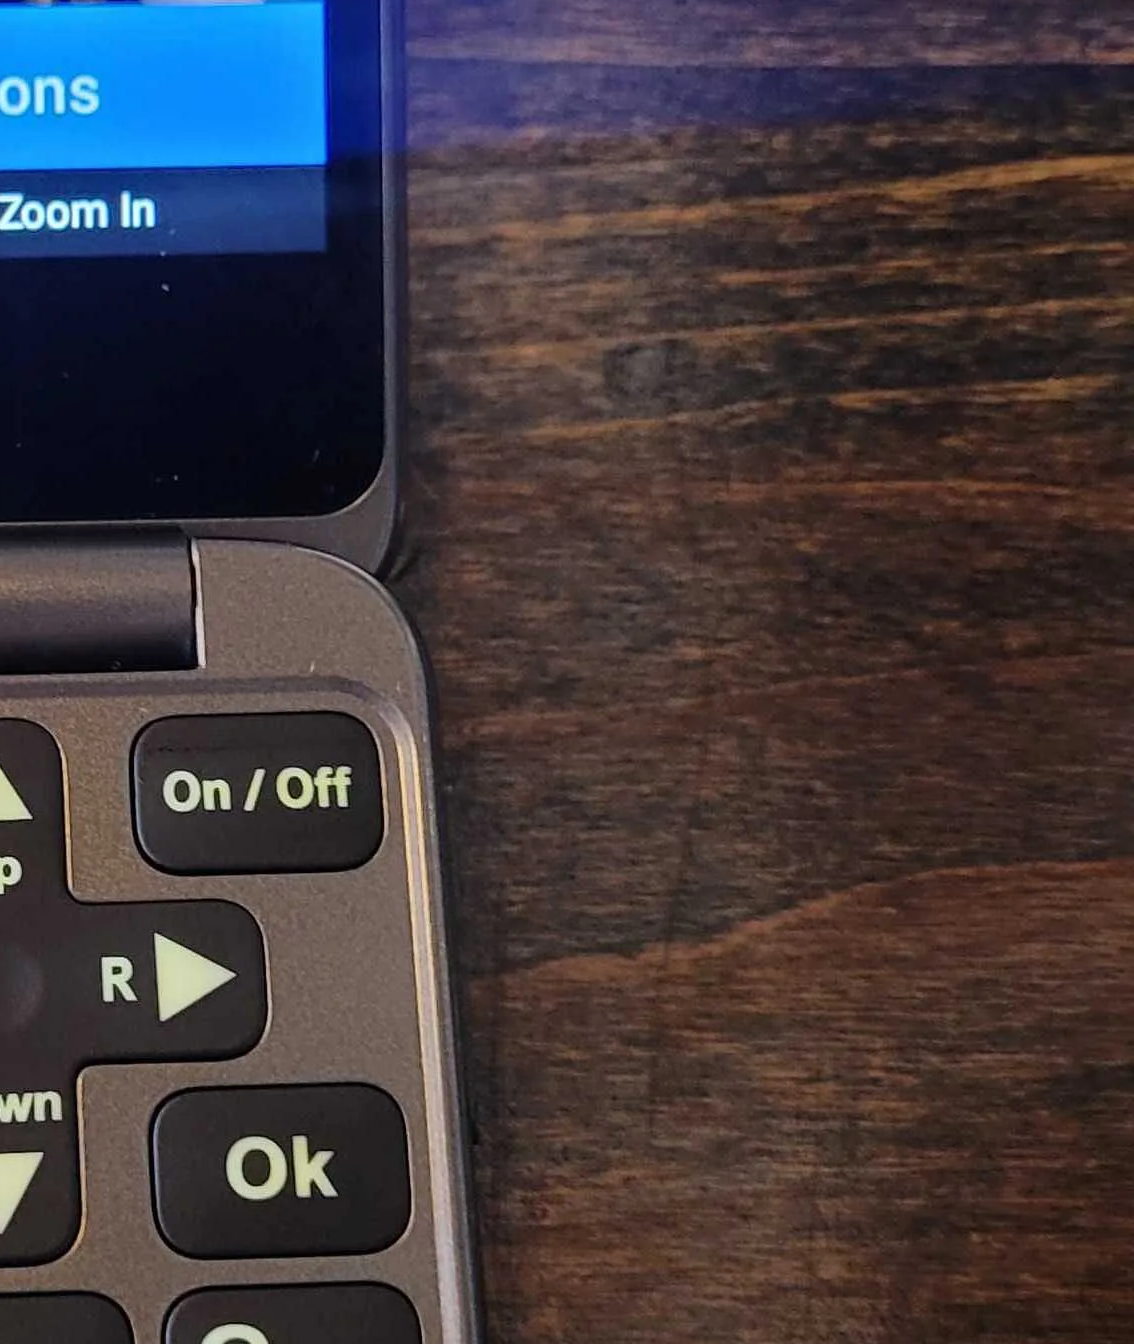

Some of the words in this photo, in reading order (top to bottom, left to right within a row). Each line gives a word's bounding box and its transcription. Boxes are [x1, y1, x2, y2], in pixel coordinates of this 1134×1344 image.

[121, 191, 155, 227] In
[102, 957, 137, 1001] R
[226, 1136, 337, 1199] Ok
